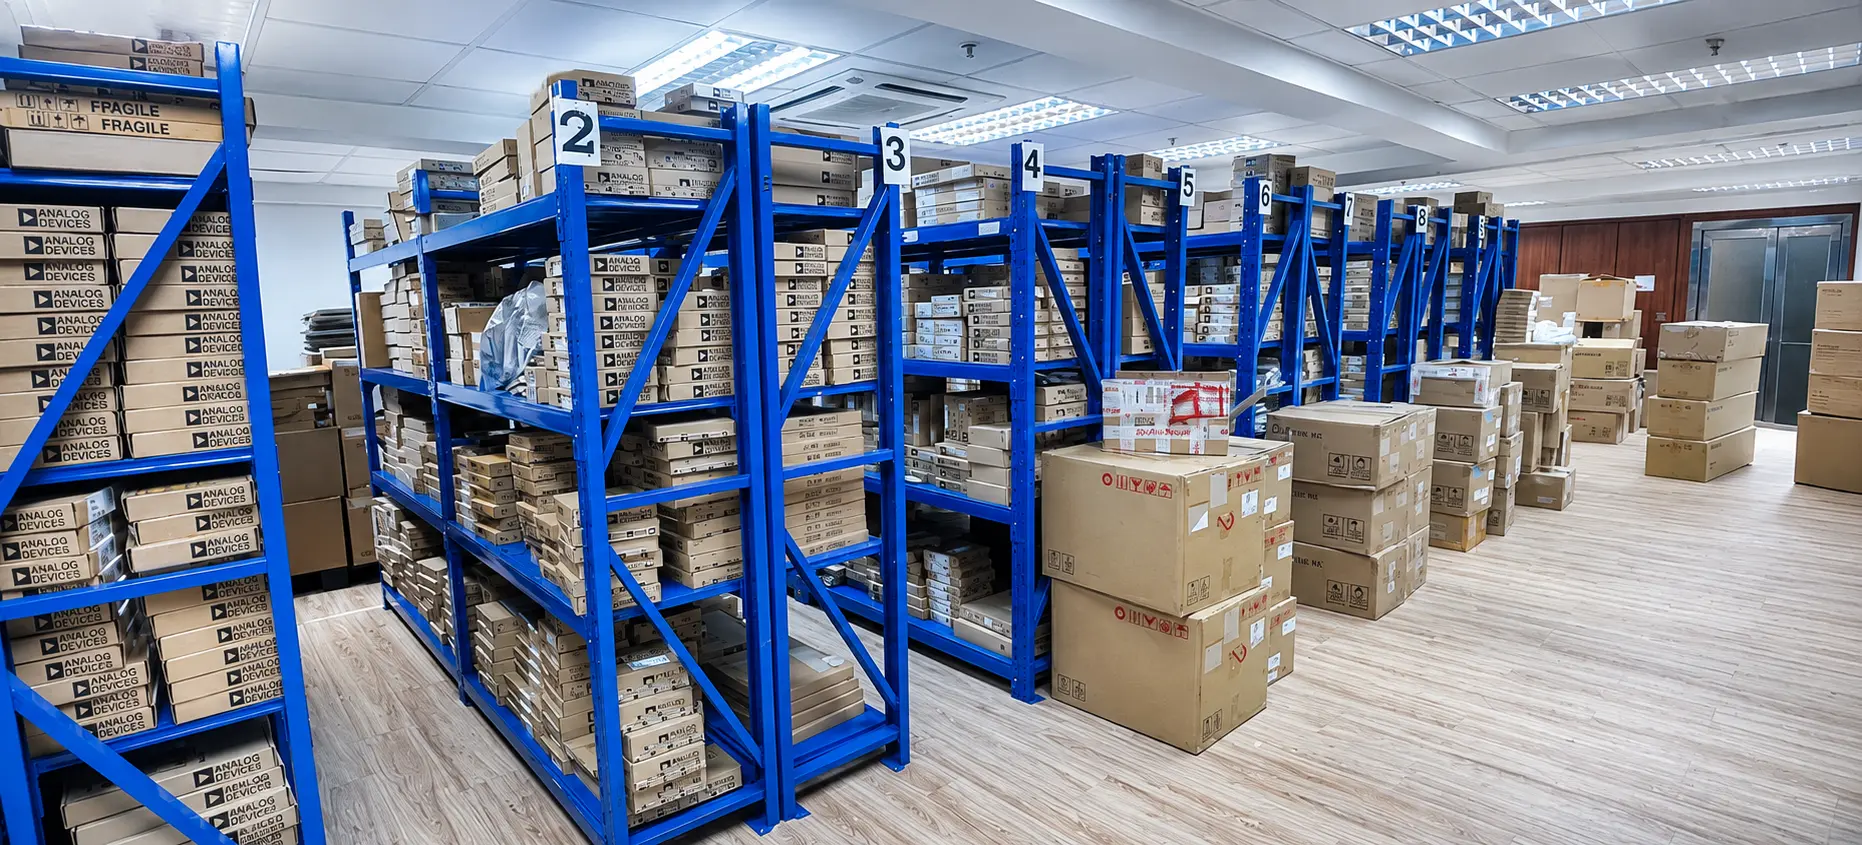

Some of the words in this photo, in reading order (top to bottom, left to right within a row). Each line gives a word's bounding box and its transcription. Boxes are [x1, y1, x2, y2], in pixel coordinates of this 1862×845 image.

[102, 119, 170, 134] FRAGILE
[560, 110, 594, 154] 2
[886, 136, 905, 171] 3
[1025, 149, 1041, 178] 4
[1184, 172, 1194, 197] 5
[1262, 184, 1270, 206] 6
[1347, 196, 1352, 217] 7
[39, 209, 90, 219] ANALOG
[1419, 209, 1426, 226] 8
[40, 219, 91, 228] DEVICES
[192, 225, 231, 233] DEVICE
[45, 237, 94, 246] ANALOG
[45, 246, 96, 255] DEVICES
[196, 250, 234, 258] DEVICE
[45, 263, 94, 271] ANALOG
[46, 272, 95, 281] DEVICES
[54, 290, 103, 298] ANALOG
[54, 299, 104, 308] DEVICES
[203, 322, 241, 330] DEVICE
[57, 342, 84, 350] ANAL
[59, 417, 106, 427] ANALOG
[60, 426, 107, 437] DEVICES
[62, 440, 109, 452] ANALOG
[63, 450, 111, 461] DEVICES
[203, 486, 244, 498] ANALOG
[204, 495, 246, 508] DEVICES
[18, 509, 63, 521] ANALOG
[20, 519, 65, 531] DEVICES
[208, 533, 248, 547] ANALOG
[32, 561, 78, 574] ANALOG
[33, 570, 80, 584] DEVICES
[233, 617, 272, 631] ANALOG
[65, 652, 111, 668] ANALOG
[91, 668, 137, 684] ANALOG
[98, 712, 143, 729] ANALOG
[99, 721, 145, 738] DEVICES
[215, 754, 260, 773] ANALOG
[230, 796, 275, 817] ANALOG
